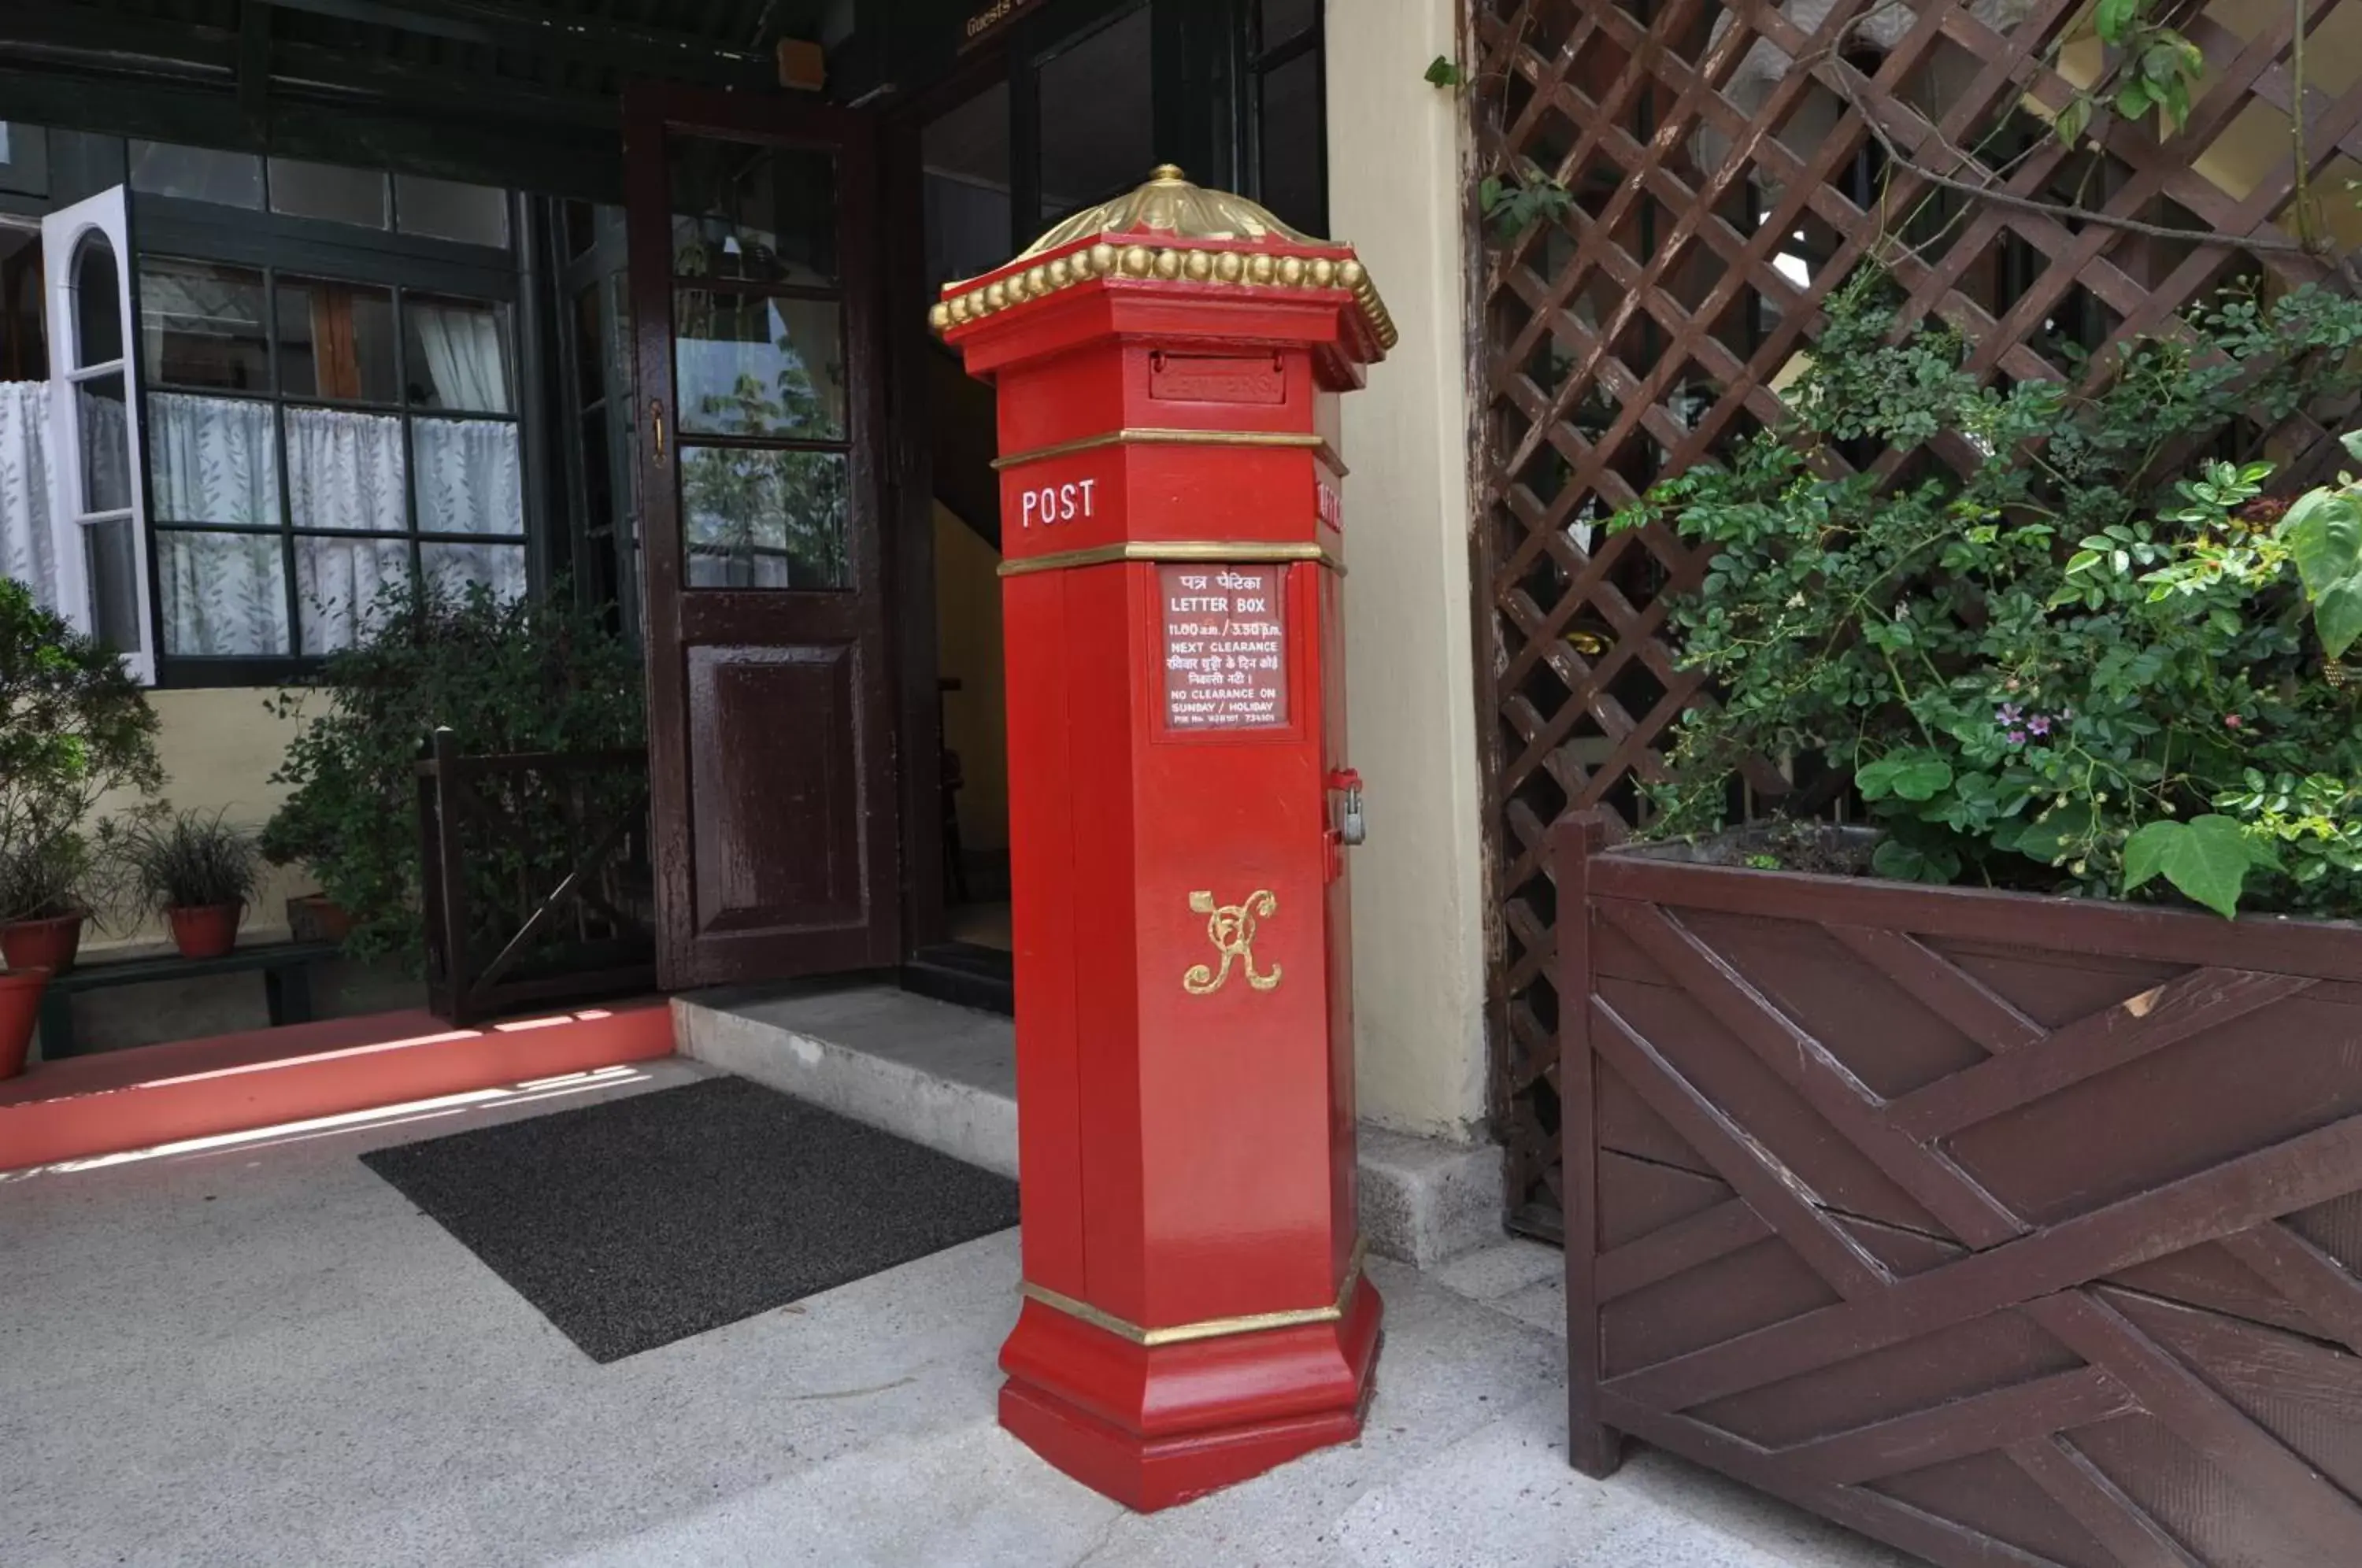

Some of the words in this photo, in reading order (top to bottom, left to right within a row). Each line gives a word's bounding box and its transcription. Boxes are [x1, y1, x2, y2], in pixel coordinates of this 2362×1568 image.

[1022, 479, 1095, 528] POST
[1179, 575, 1208, 590] पत्र
[1171, 597, 1229, 612] LETTER
[1237, 597, 1265, 612] BOX
[1171, 642, 1205, 653] NEXT
[1209, 642, 1279, 653] CLEARANCE
[1171, 690, 1187, 700] NO
[1191, 689, 1254, 700] CLEARANCE
[1261, 687, 1276, 698] ON
[1171, 702, 1216, 712] SUNDAY
[1229, 701, 1274, 712] HOLIDAY
